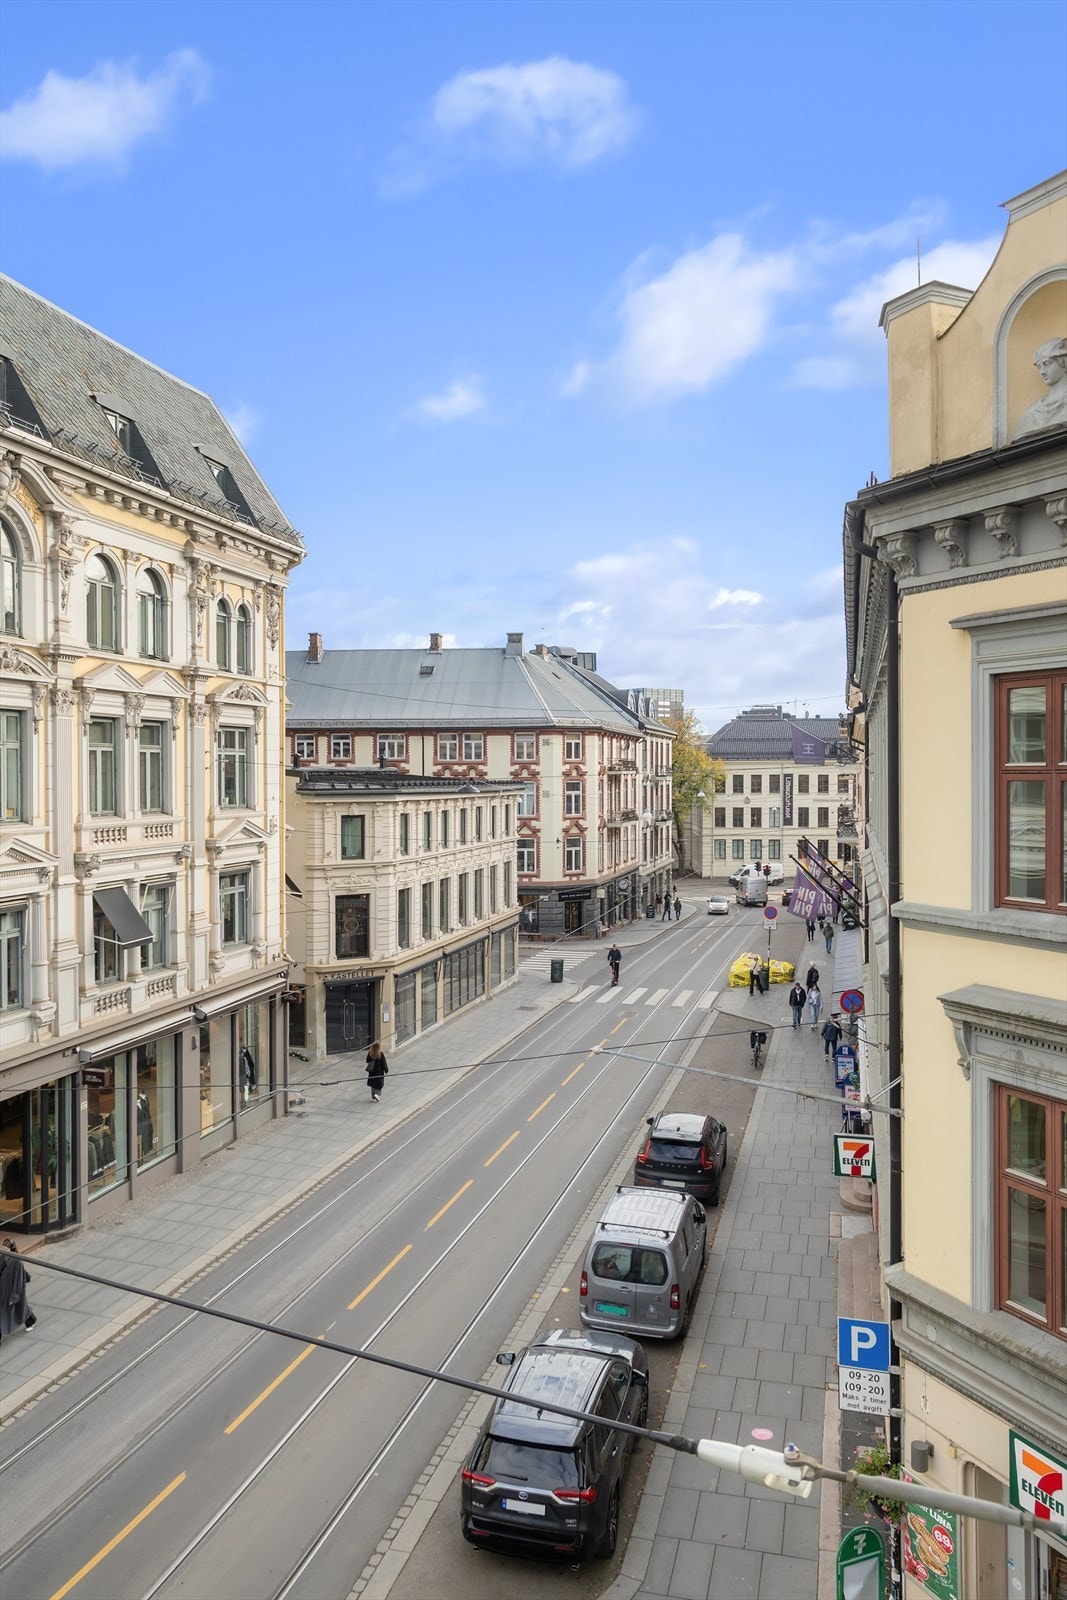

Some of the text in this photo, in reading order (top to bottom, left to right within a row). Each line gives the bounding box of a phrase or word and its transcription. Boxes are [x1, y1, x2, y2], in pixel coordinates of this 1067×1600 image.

[331, 969, 375, 981] KASTELLET
[843, 1141, 869, 1176] 7
[851, 1325, 877, 1362] P
[842, 1393, 859, 1401] Maks
[870, 1397, 887, 1405] timer
[847, 1402, 882, 1413] mot avgift
[1022, 1449, 1063, 1521] 7
